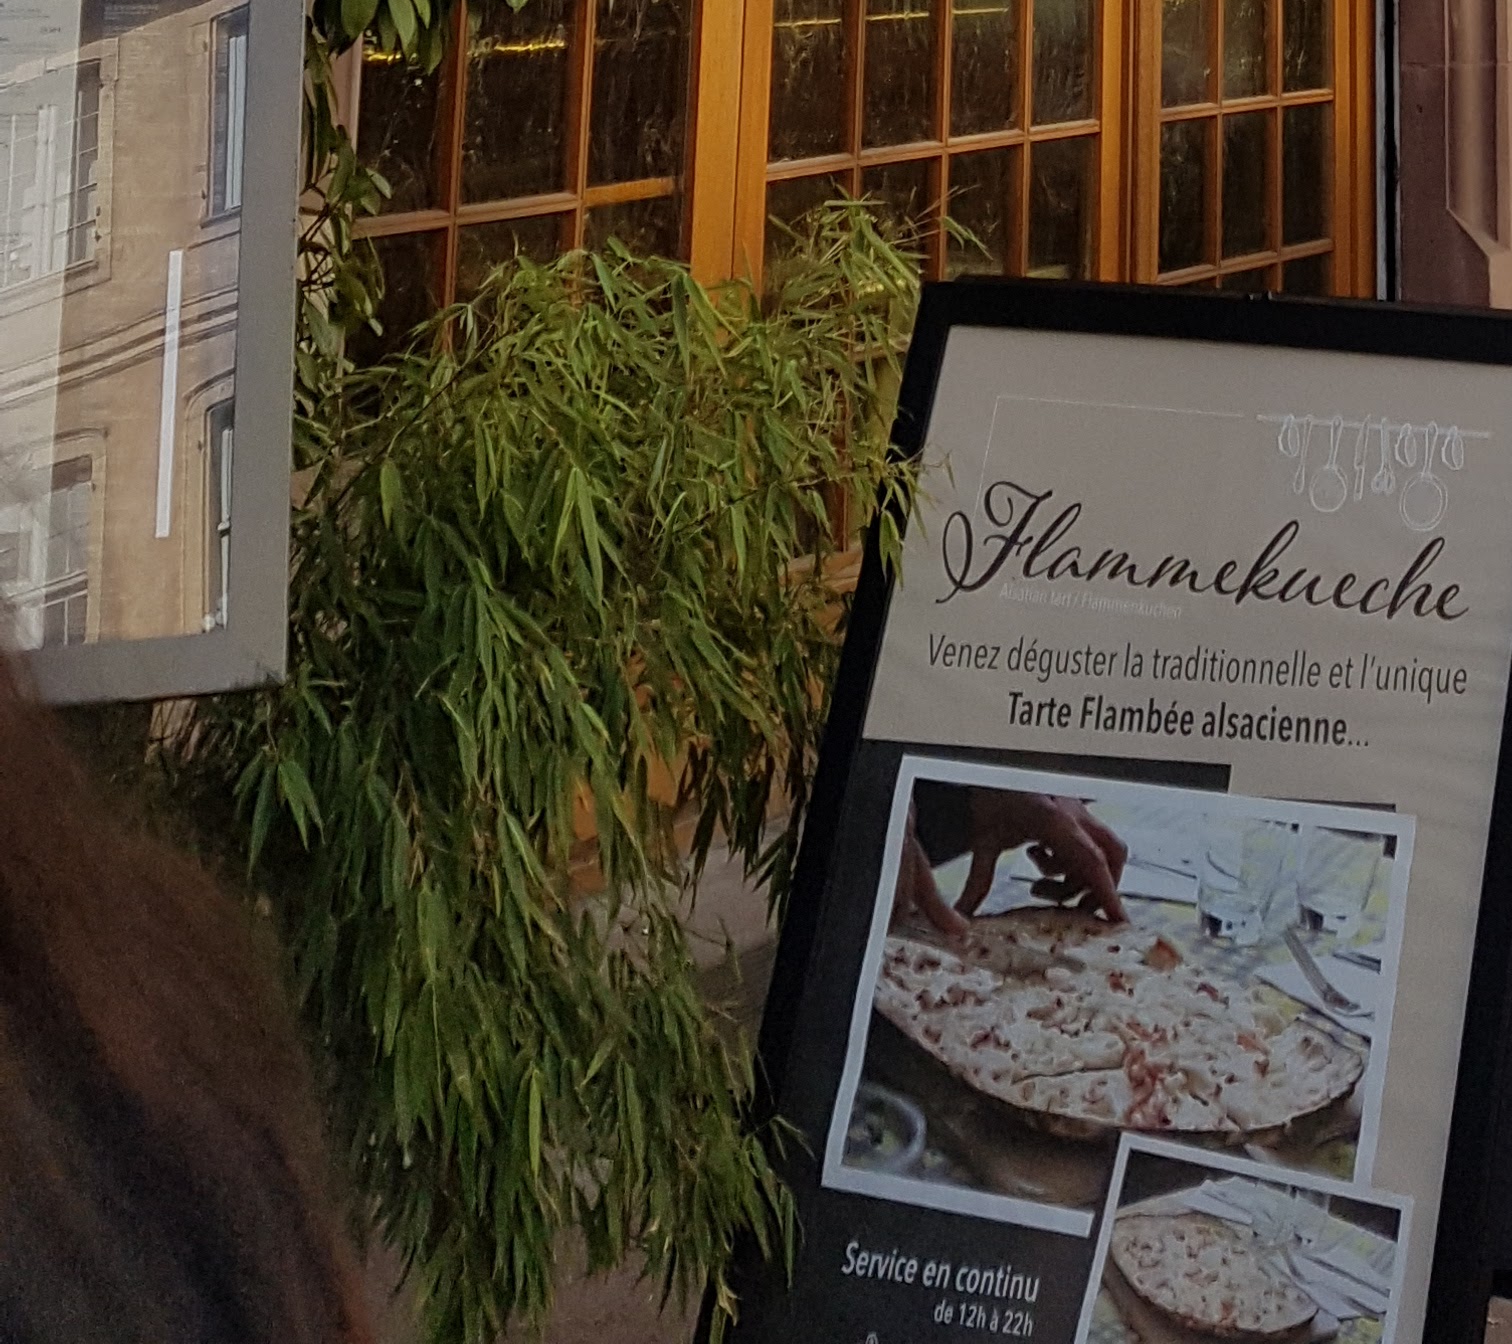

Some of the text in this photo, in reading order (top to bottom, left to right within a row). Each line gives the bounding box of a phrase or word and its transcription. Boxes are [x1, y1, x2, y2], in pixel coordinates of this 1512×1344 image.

[936, 481, 1469, 621] Flammekueche
[928, 633, 1467, 704] Venez déguster la traditionnelle et l'unique
[1008, 691, 1369, 747] Tarte Flambée alsacienne...
[841, 1240, 1040, 1303] Service en continu
[934, 1298, 1033, 1337] de 12h à 22h
